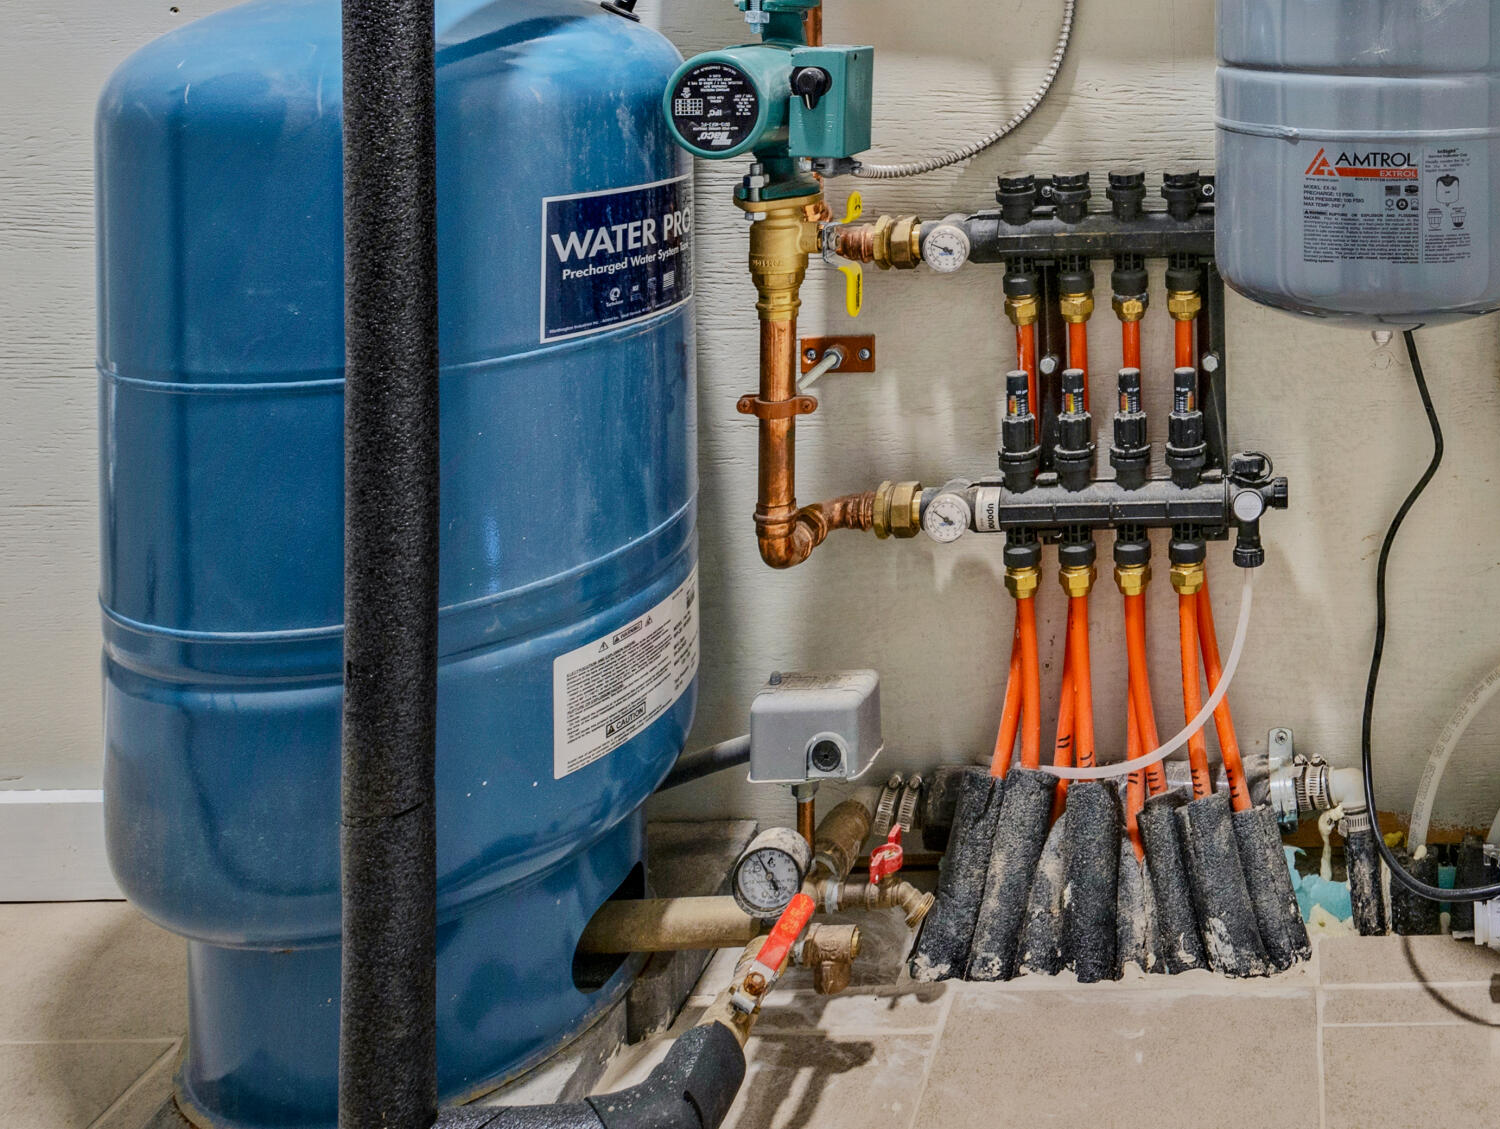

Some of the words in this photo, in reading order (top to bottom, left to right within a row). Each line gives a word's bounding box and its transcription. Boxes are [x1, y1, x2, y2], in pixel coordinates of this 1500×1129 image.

[699, 131, 732, 145] Taco
[1335, 152, 1417, 167] AMTROL
[1379, 169, 1417, 178] EXTROL
[551, 218, 657, 262] WATER
[663, 207, 691, 241] PRO
[562, 258, 628, 280] Precharged
[630, 253, 656, 267] Water
[657, 246, 679, 262] System
[616, 705, 644, 729] CAUTION
